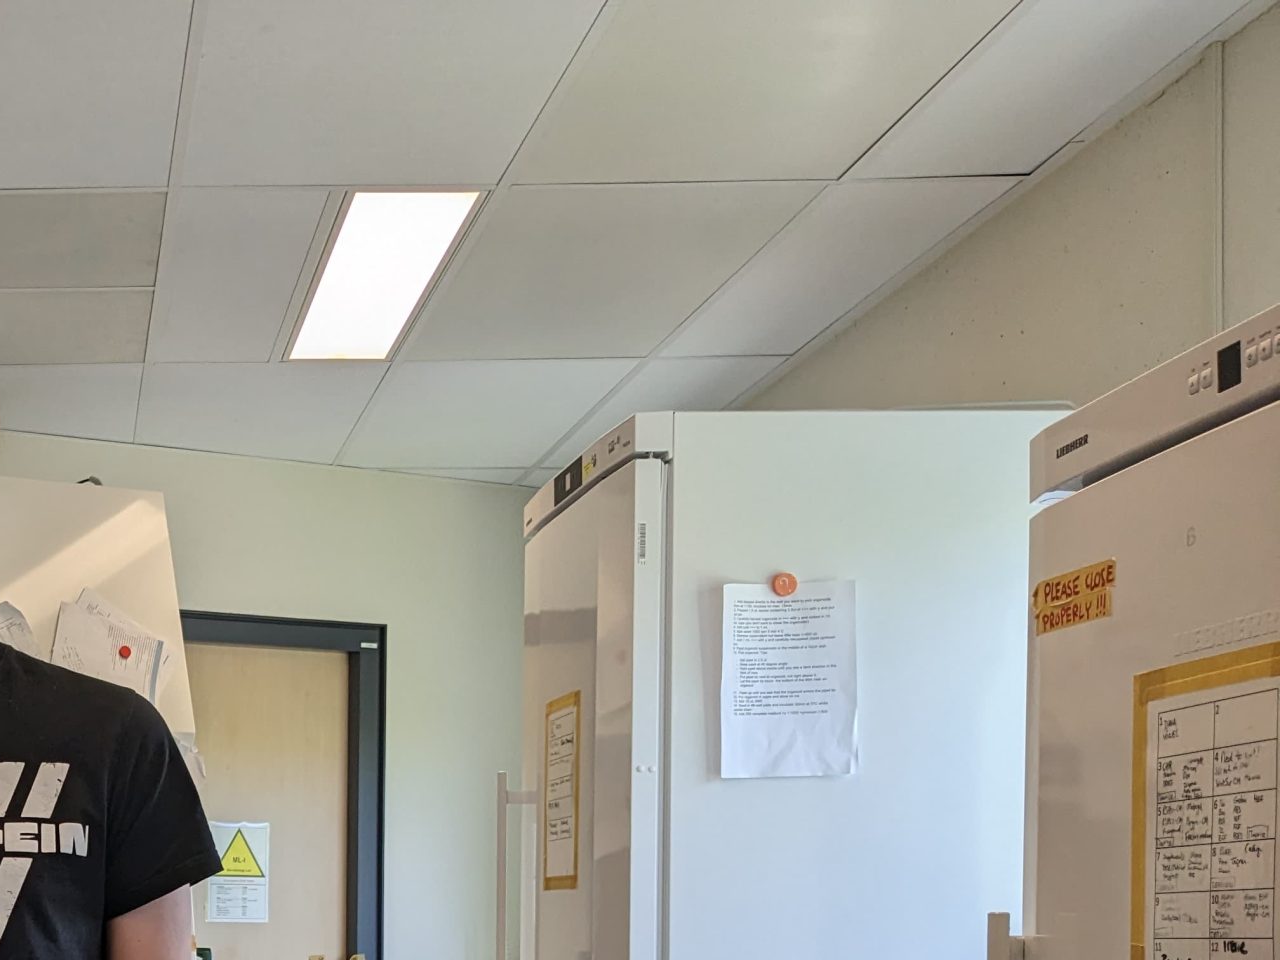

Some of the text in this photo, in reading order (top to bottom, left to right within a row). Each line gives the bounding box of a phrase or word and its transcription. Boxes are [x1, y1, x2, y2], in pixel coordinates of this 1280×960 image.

[1056, 433, 1089, 459] LIEBHERR
[1044, 565, 1115, 604] PLEASE CLOSE
[1042, 593, 1106, 632] PROPERLY !!!
[1211, 895, 1219, 905] 10
[1211, 943, 1219, 952] 12
